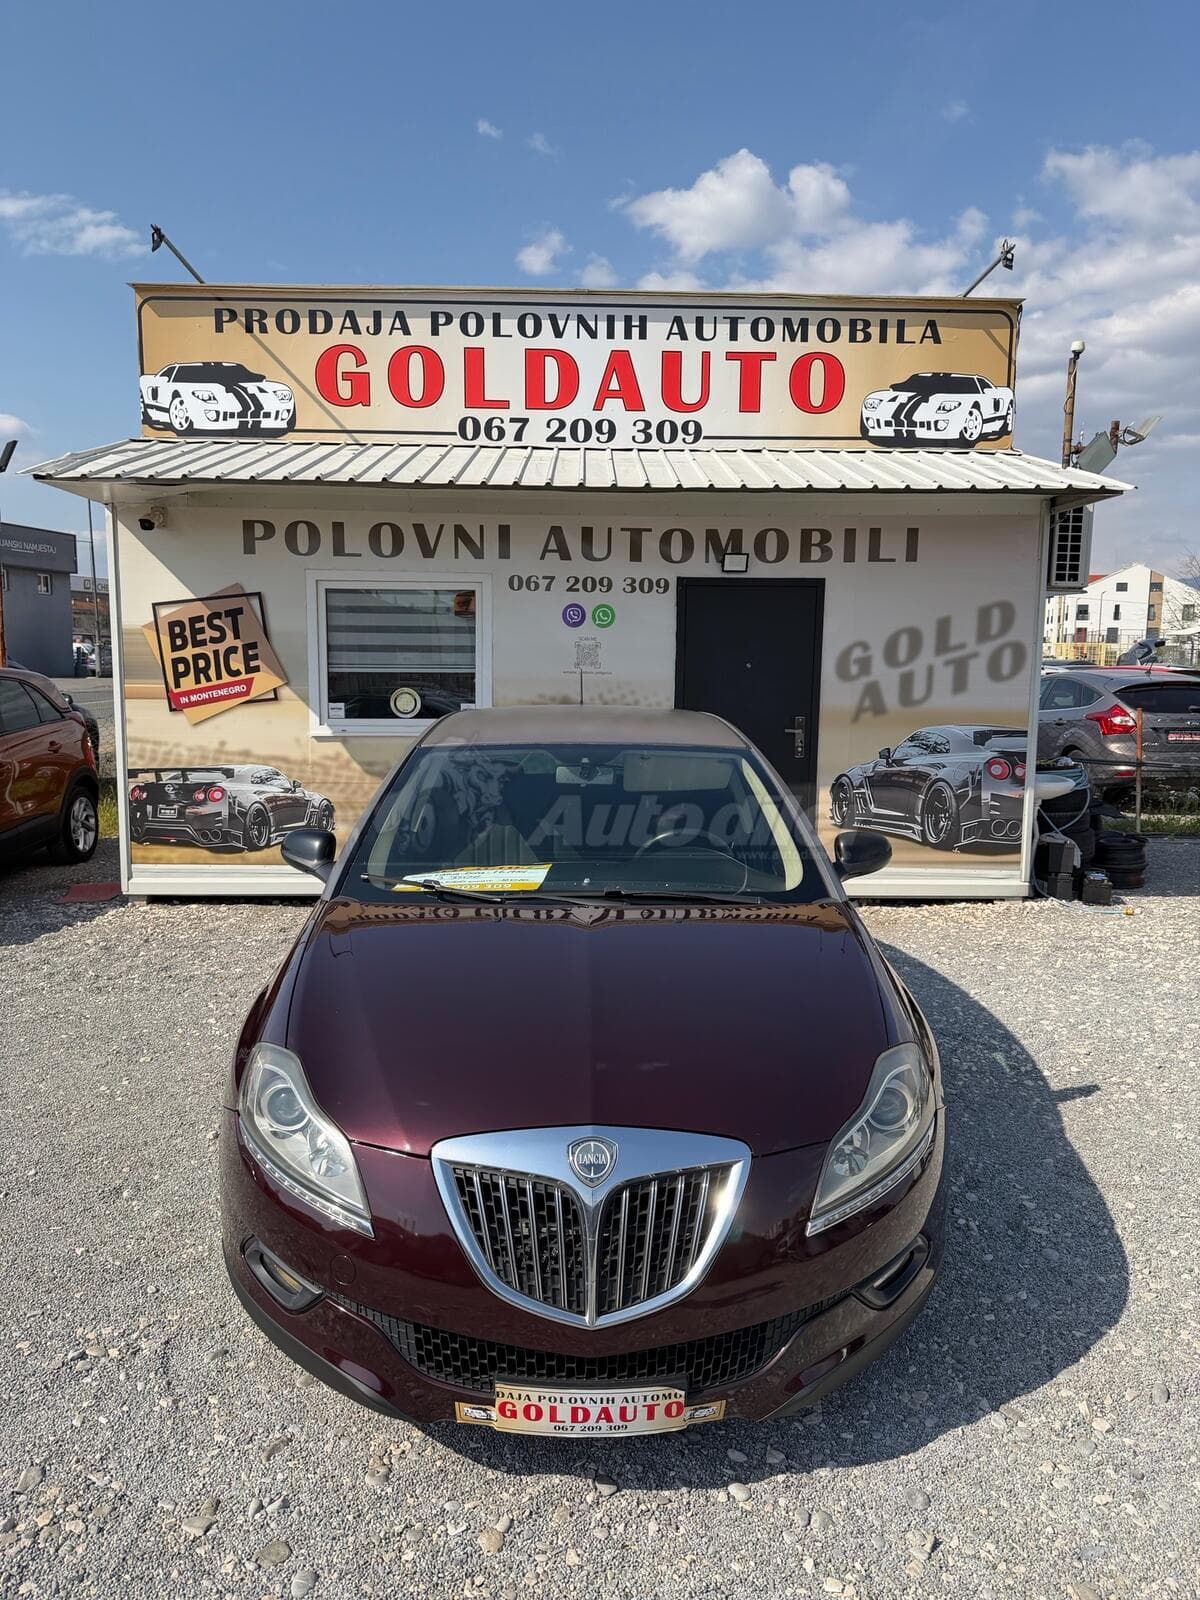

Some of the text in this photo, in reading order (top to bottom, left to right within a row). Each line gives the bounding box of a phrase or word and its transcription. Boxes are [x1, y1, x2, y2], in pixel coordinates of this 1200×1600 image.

[213, 307, 942, 345] PRODAJA POLOVNIH AUTOMOBILA
[314, 343, 846, 415] GOLDAUTO
[457, 416, 703, 445] 067 209 309
[242, 519, 920, 564] POLOVNI AUTOMOBILI
[508, 574, 670, 594] 067 209 309
[167, 606, 244, 653] BEST
[835, 600, 1016, 683] GOLD
[171, 641, 261, 690] PRICE
[851, 640, 1027, 724] AUTO
[180, 684, 247, 705] IN MONTENEGRO
[579, 1153, 606, 1165] LANCIA
[496, 1391, 682, 1405] DAJA POLOVNIH AUTOMO
[498, 1401, 684, 1424] GOLDAUTO
